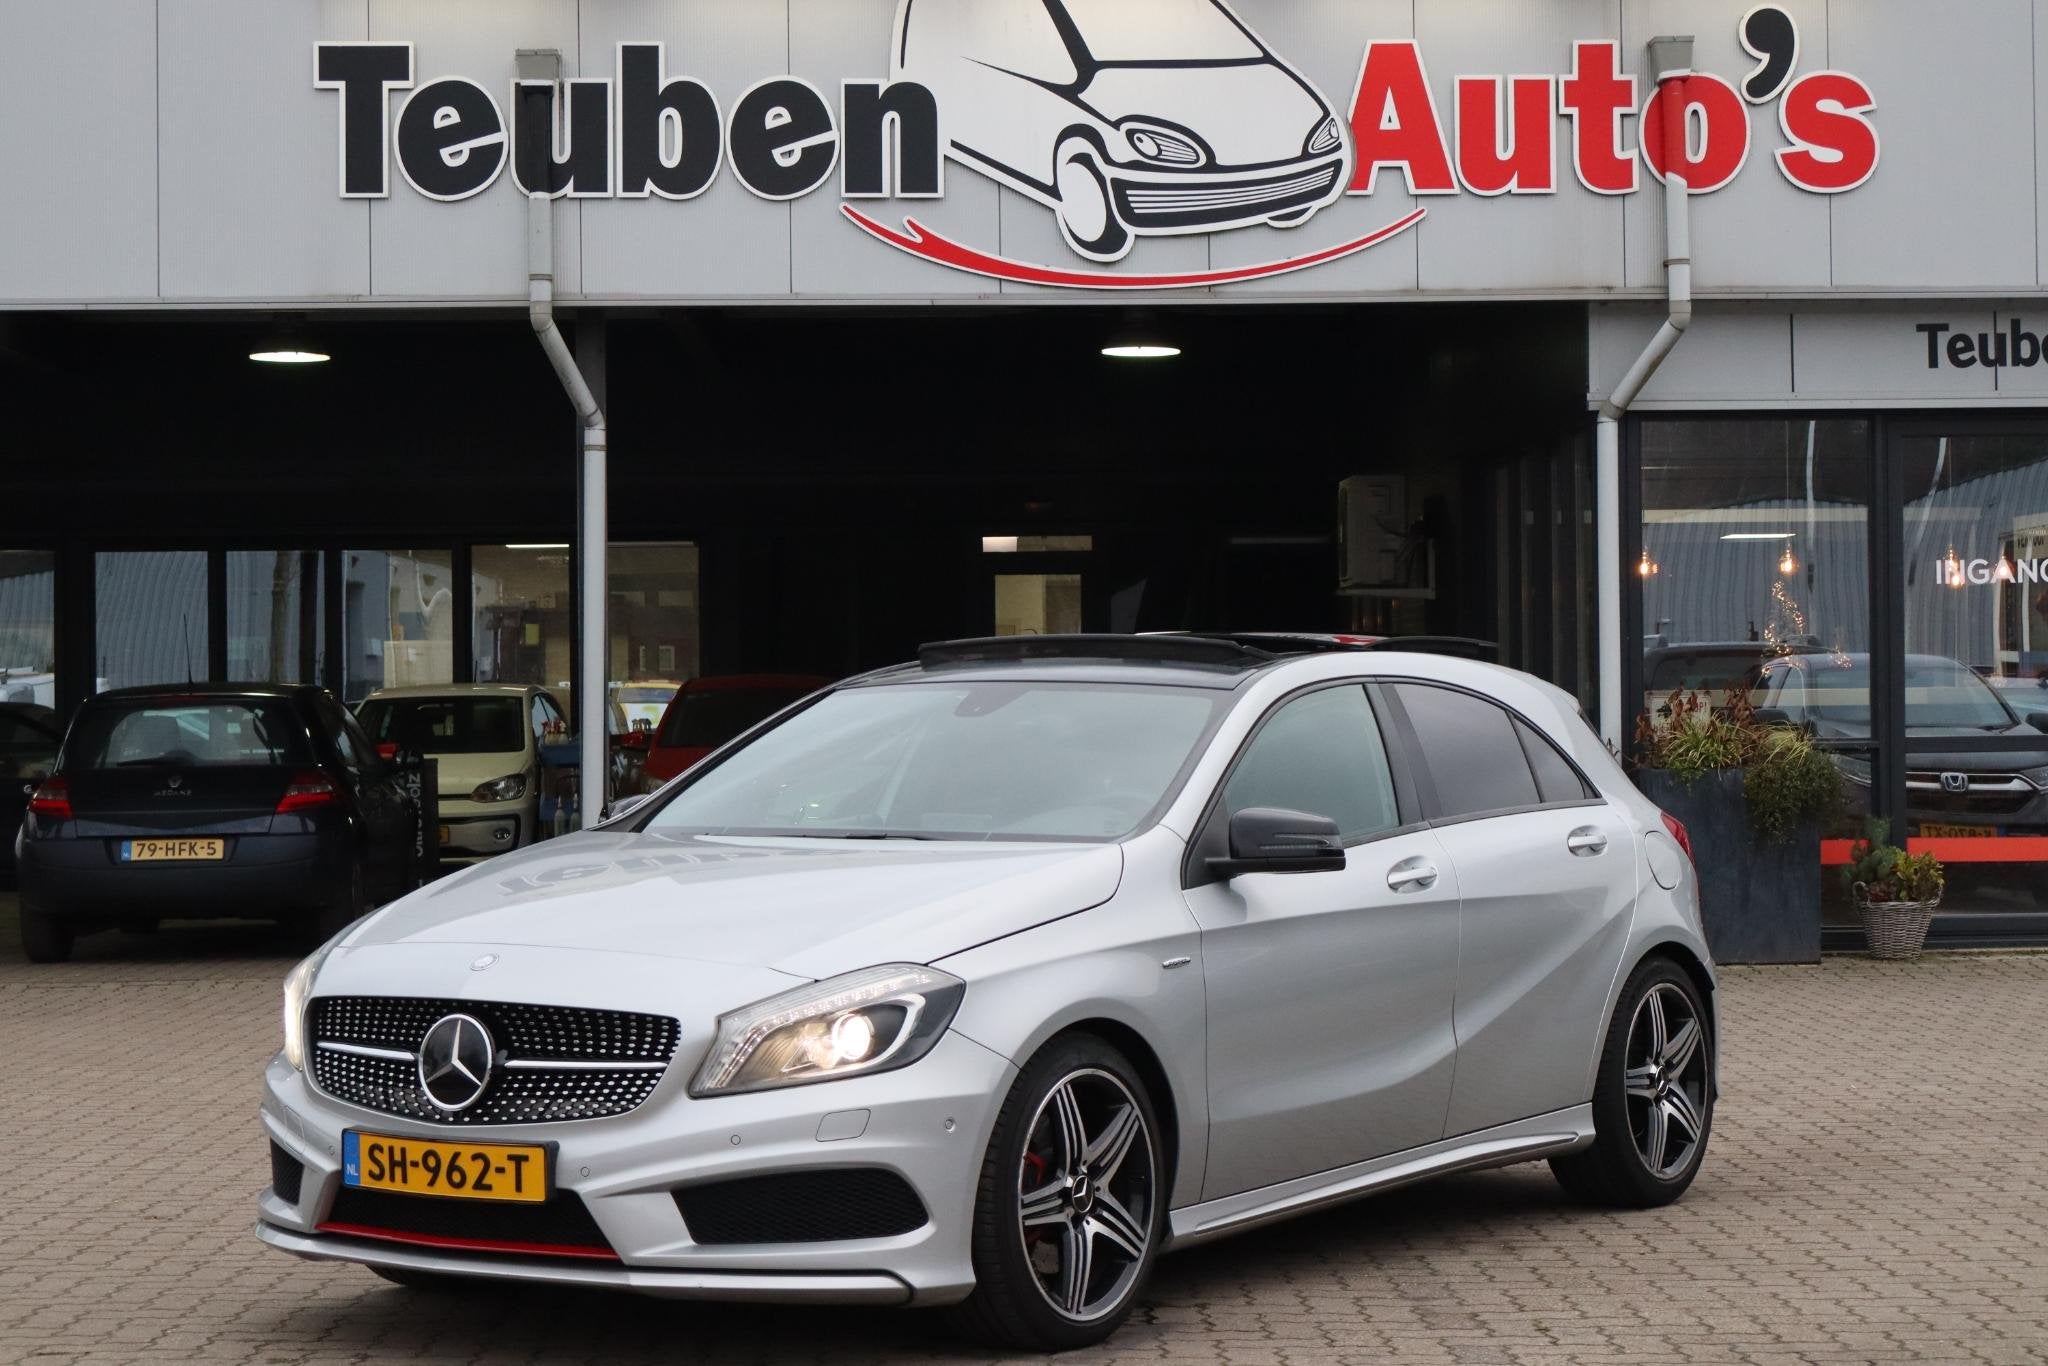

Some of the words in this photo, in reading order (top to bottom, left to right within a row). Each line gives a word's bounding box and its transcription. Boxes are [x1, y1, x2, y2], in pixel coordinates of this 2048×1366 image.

[313, 41, 944, 201] Teuben
[1346, 4, 1879, 195] Auto's
[1916, 318, 2048, 368] Teub
[136, 842, 217, 857] 79-HFK-5
[346, 1163, 358, 1176] NL
[368, 1143, 529, 1193] SH-962-T
